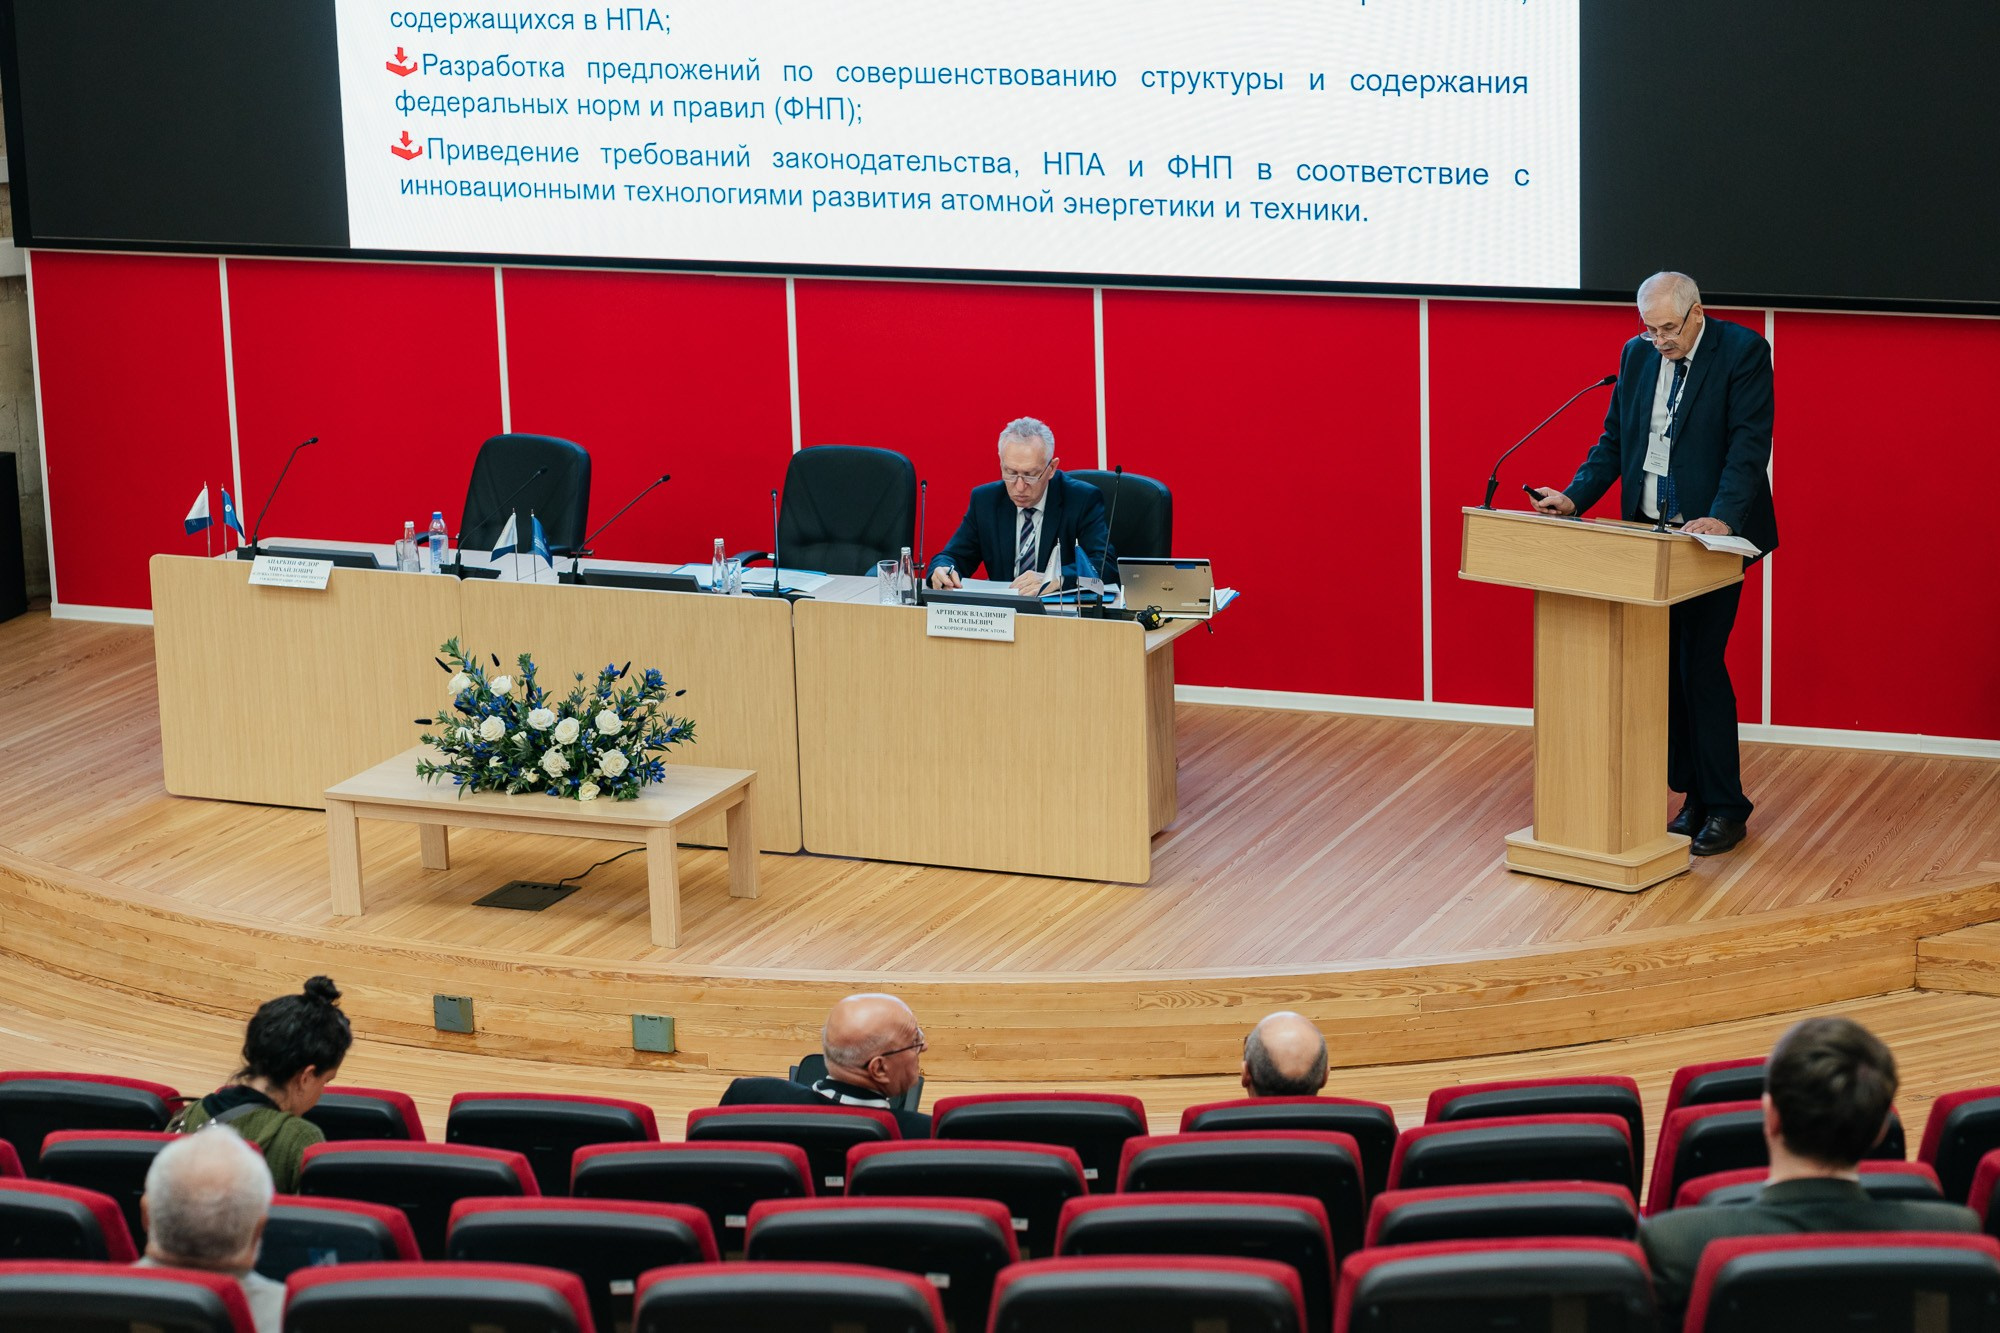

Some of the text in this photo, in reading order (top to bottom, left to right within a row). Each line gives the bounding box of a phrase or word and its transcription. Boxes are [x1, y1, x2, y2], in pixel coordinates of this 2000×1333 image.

[389, 7, 672, 35] содержащихся в НПА;
[421, 52, 1529, 100] Разработка предложений по совершенствованию структуры и содержания
[394, 88, 863, 127] федеральных норм и правил (ФНП);
[426, 136, 1531, 188] Приведение требований законодательства, НПА и ФНП в соответствие с
[399, 178, 1369, 223] инновационными технологиями развития атомной энергетики и техники.
[935, 609, 1008, 619] АРТИСЮК ВЛАДИМИР
[948, 617, 993, 626] ВАСИЛЬЕВИЧ
